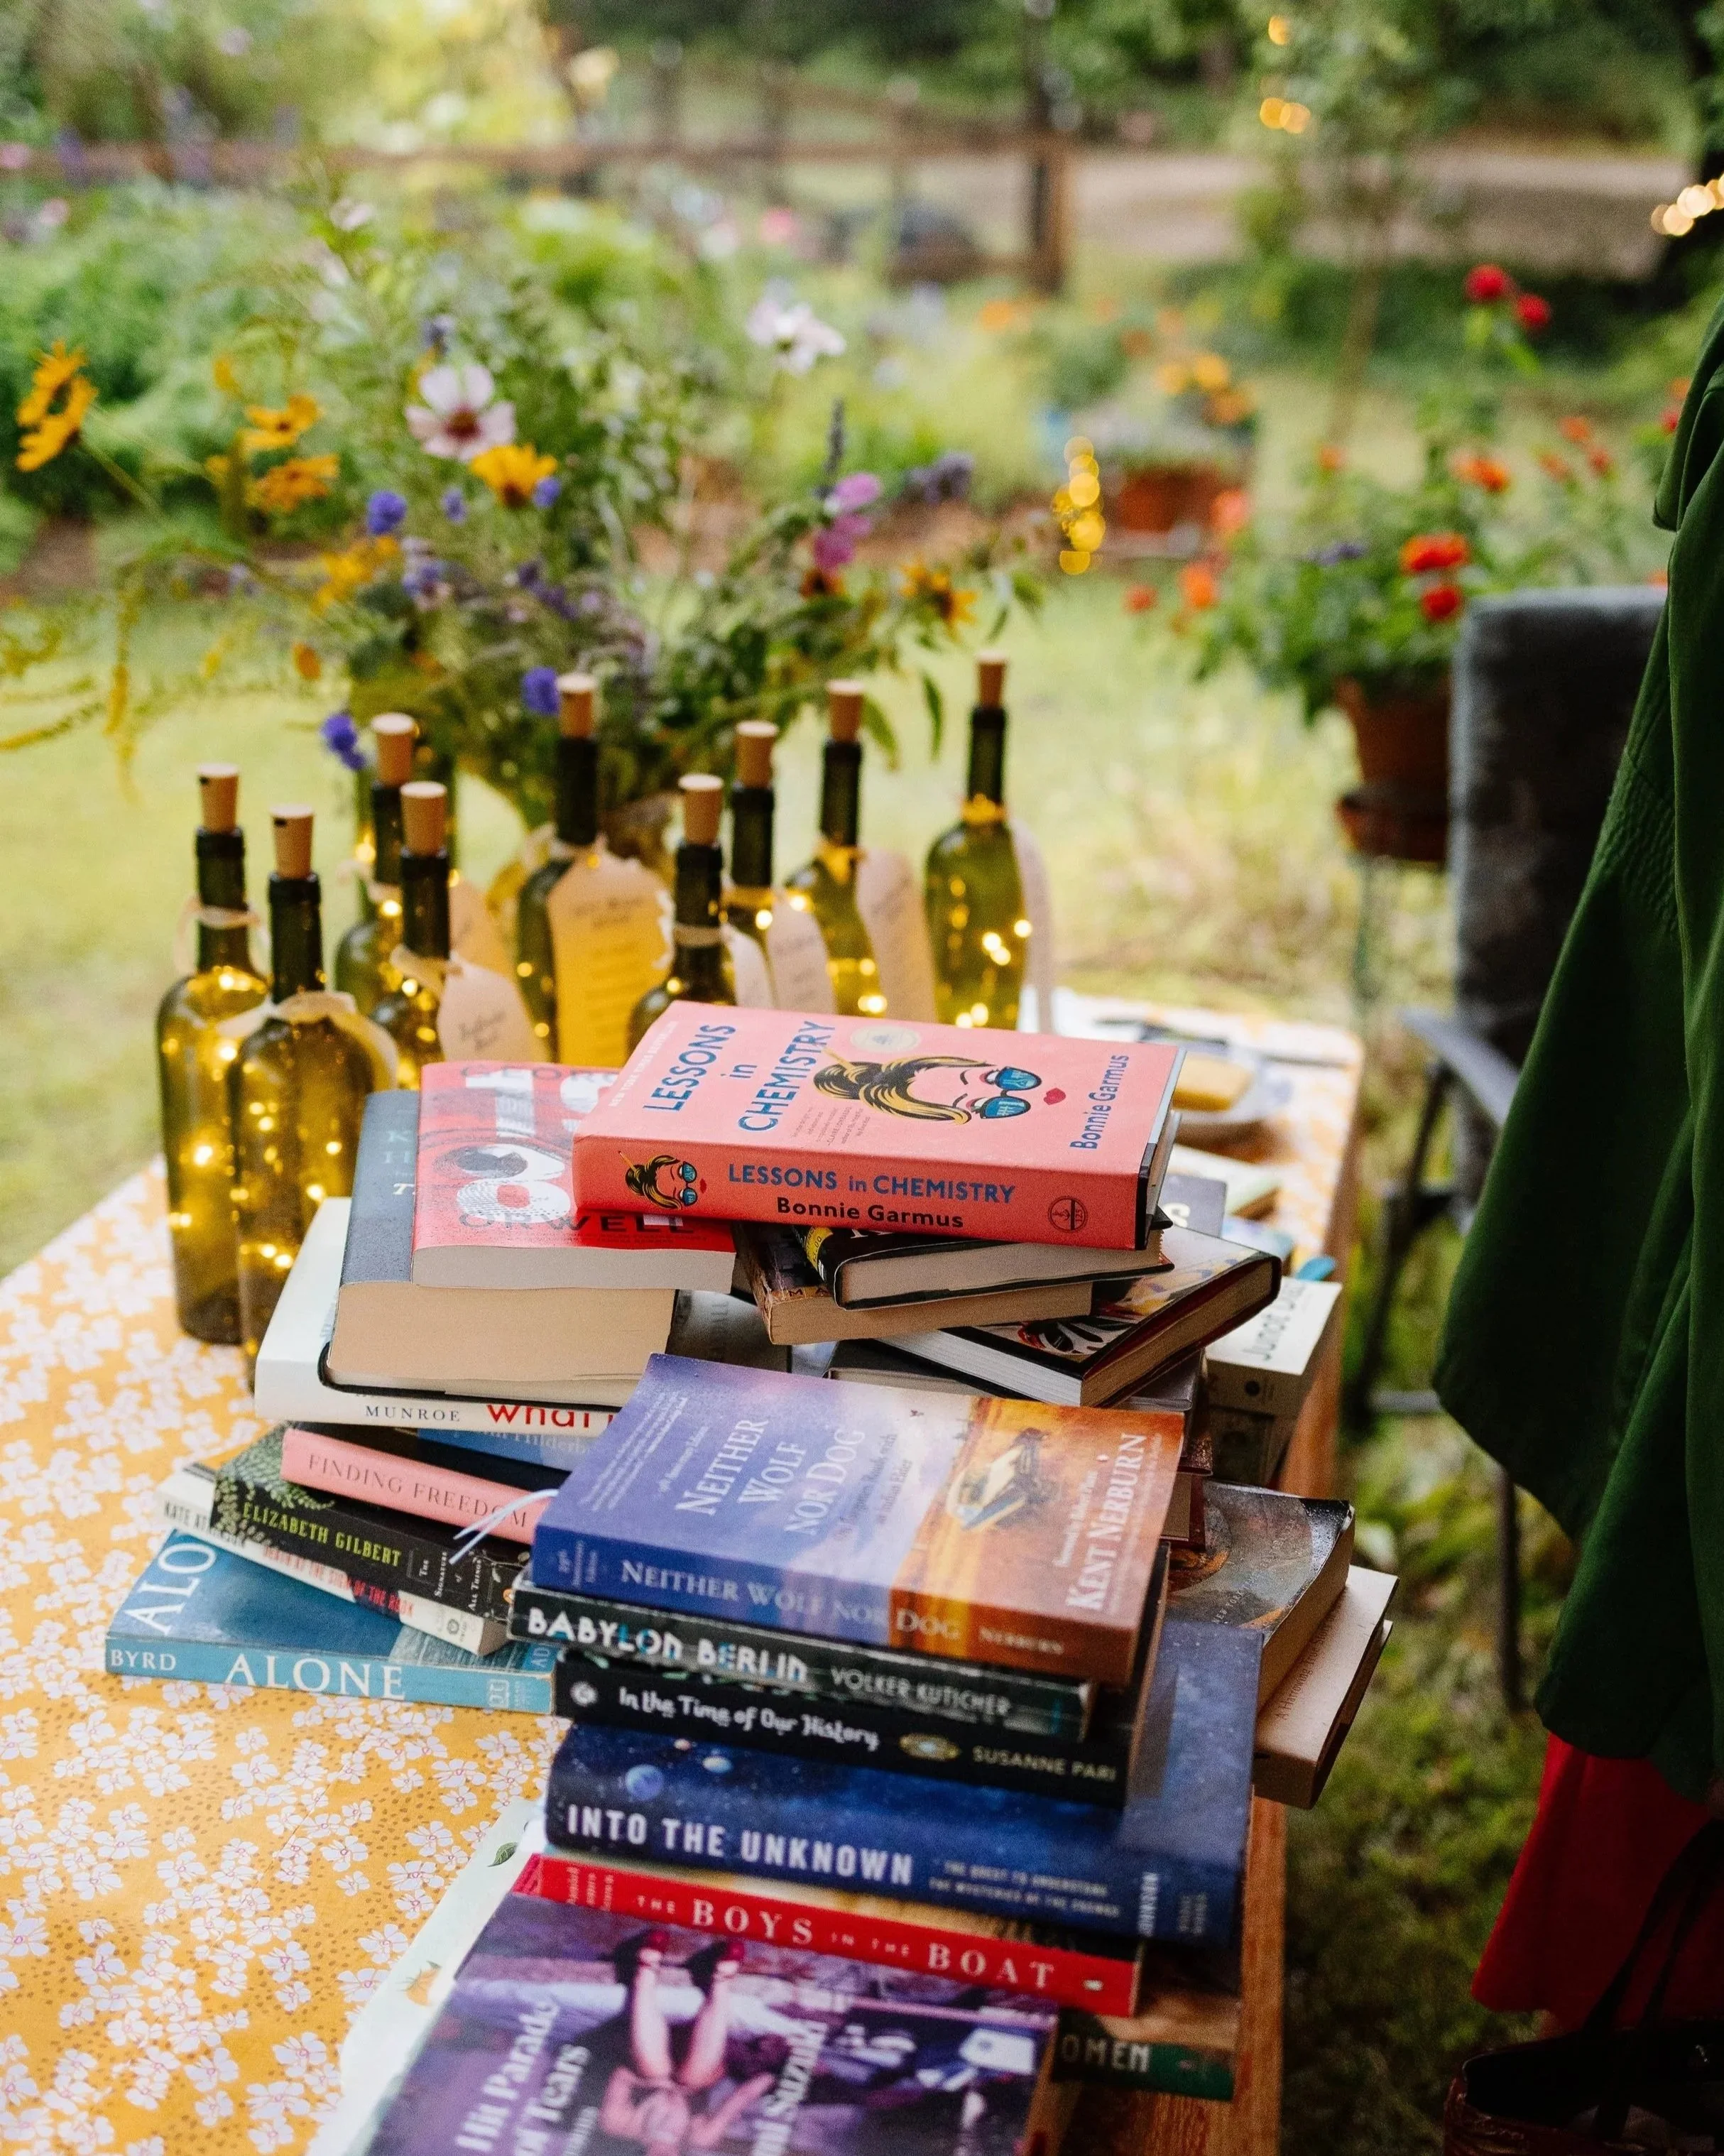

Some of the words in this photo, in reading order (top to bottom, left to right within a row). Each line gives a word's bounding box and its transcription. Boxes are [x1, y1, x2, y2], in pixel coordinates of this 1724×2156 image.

[643, 1024, 737, 1111] LESSONS
[721, 1065, 758, 1079] in
[738, 1021, 835, 1131] CHEMISTRY
[1089, 1055, 1129, 1102] Garmus
[1070, 1105, 1111, 1150] Bonnie
[729, 1164, 837, 1190] LESSONS
[849, 1175, 866, 1192] in
[873, 1176, 1015, 1204] CHEMISTRY
[777, 1197, 860, 1219] Bonnie
[868, 1205, 964, 1227] Garmus
[459, 1212, 694, 1234] ORWELL
[366, 1405, 460, 1422] MUNROE
[310, 1454, 404, 1493] FINDING
[675, 1420, 768, 1515] NEITHER
[736, 1442, 808, 1503] WOLF
[807, 1428, 867, 1493] DOG
[1086, 1432, 1147, 1542] NERBURN
[244, 1502, 329, 1544] ELIZABETH
[335, 1532, 402, 1567] GILBERT
[783, 1490, 836, 1536] NOR
[126, 1541, 216, 1636] ALO
[622, 1559, 738, 1602] NEITHER
[896, 1608, 961, 1640] DOG
[1066, 1545, 1117, 1610] KENT
[110, 1648, 176, 1672] BYRD
[224, 1653, 407, 1702] ALONE
[528, 1607, 682, 1661] BABYLON
[697, 1638, 808, 1682] BERLIN
[831, 1666, 910, 1697] VOLKER
[1279, 1669, 1314, 1713] Harrowing
[619, 1687, 638, 1706] In
[641, 1690, 675, 1717] the
[678, 1694, 730, 1727] Time
[734, 1707, 758, 1731] of
[760, 1708, 797, 1735] Our
[800, 1714, 880, 1752] History
[973, 1746, 1065, 1775] SUSANNE
[1071, 1762, 1116, 1781] PARI
[568, 1804, 647, 1846] INTO
[662, 1818, 725, 1858] THE
[741, 1830, 913, 1886] UNKNOWN
[638, 1895, 676, 1915] THE
[692, 1900, 813, 1945] BOYS
[928, 1942, 1055, 1989] BOAT
[1061, 2035, 1151, 2074] OMEN
